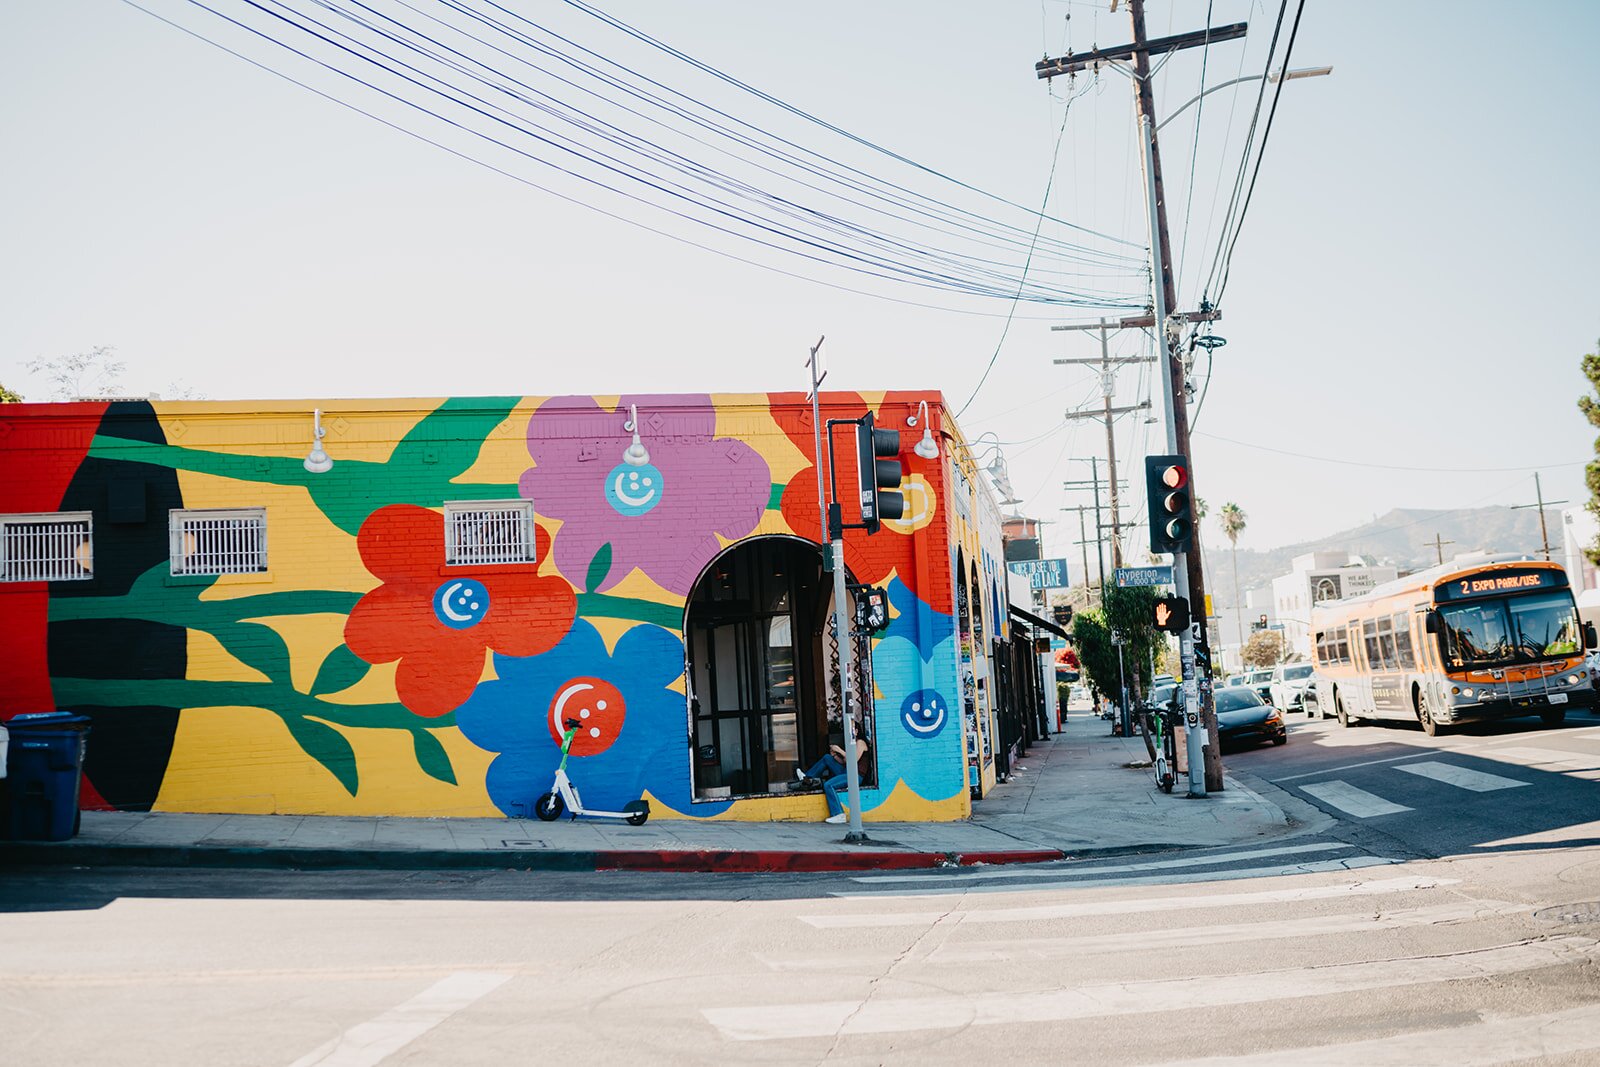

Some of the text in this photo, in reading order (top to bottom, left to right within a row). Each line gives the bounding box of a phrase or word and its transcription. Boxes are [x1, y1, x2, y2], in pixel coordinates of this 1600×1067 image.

[1028, 562, 1036, 574] TO
[1036, 561, 1048, 573] SEE
[1048, 560, 1061, 572] YOU
[1042, 571, 1061, 587] LAKE
[1118, 569, 1157, 581] Hyperion
[1461, 575, 1540, 594] 2 EXPO PARK/USC
